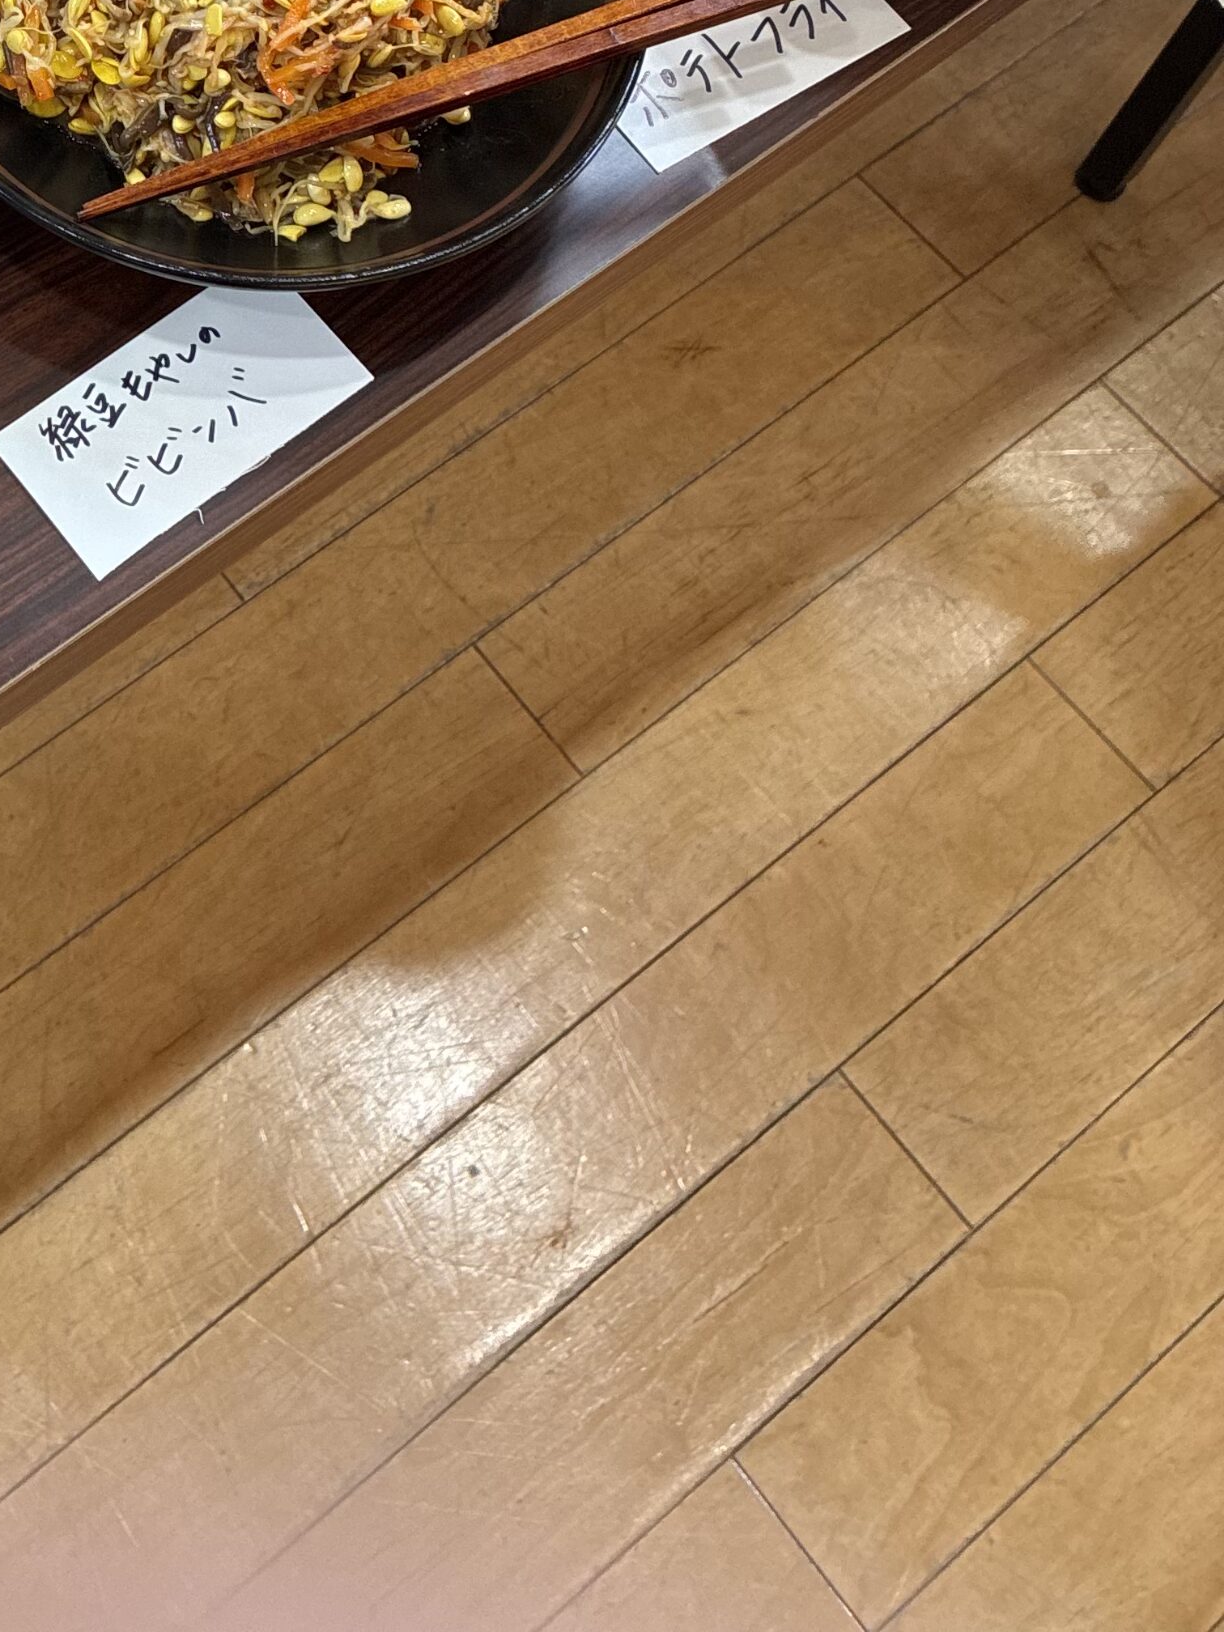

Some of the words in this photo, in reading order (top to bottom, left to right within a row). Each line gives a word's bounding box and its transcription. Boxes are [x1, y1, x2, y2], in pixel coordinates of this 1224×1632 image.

[38, 325, 221, 462] 緑豆もやしの
[106, 366, 267, 506] ビビンバ
